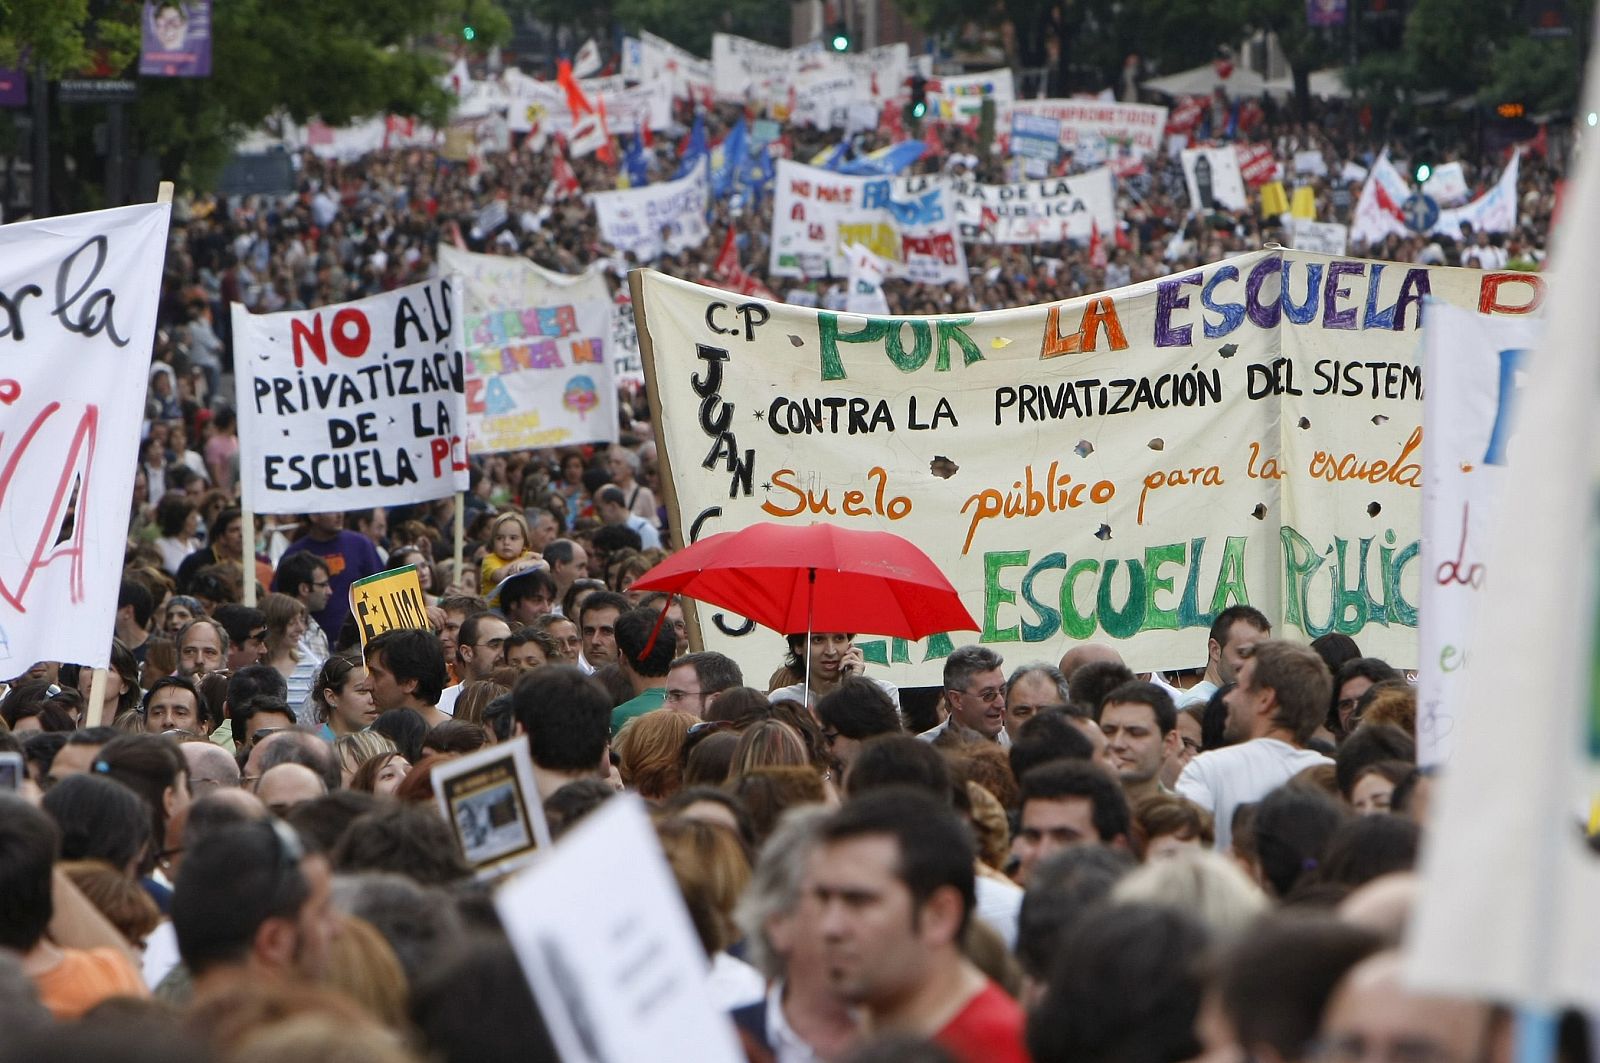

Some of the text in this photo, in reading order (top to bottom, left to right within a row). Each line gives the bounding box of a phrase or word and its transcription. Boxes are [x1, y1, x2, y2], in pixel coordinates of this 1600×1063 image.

[1000, 187, 1028, 200] DE
[1040, 180, 1071, 196] LA
[51, 234, 130, 347] la
[817, 312, 986, 381] POR
[1039, 296, 1130, 361] LA
[1154, 256, 1431, 348] ESCUELA
[291, 308, 371, 368] NO
[329, 412, 378, 449] DE
[412, 400, 450, 437] LA
[768, 358, 1425, 435] CONTRA LA PRIVATIZACIÓN DEL SISTEM
[265, 447, 418, 491] ESCUELA
[761, 425, 1424, 557] Suelo público para la escuela
[979, 536, 1248, 644] ESCUELA
